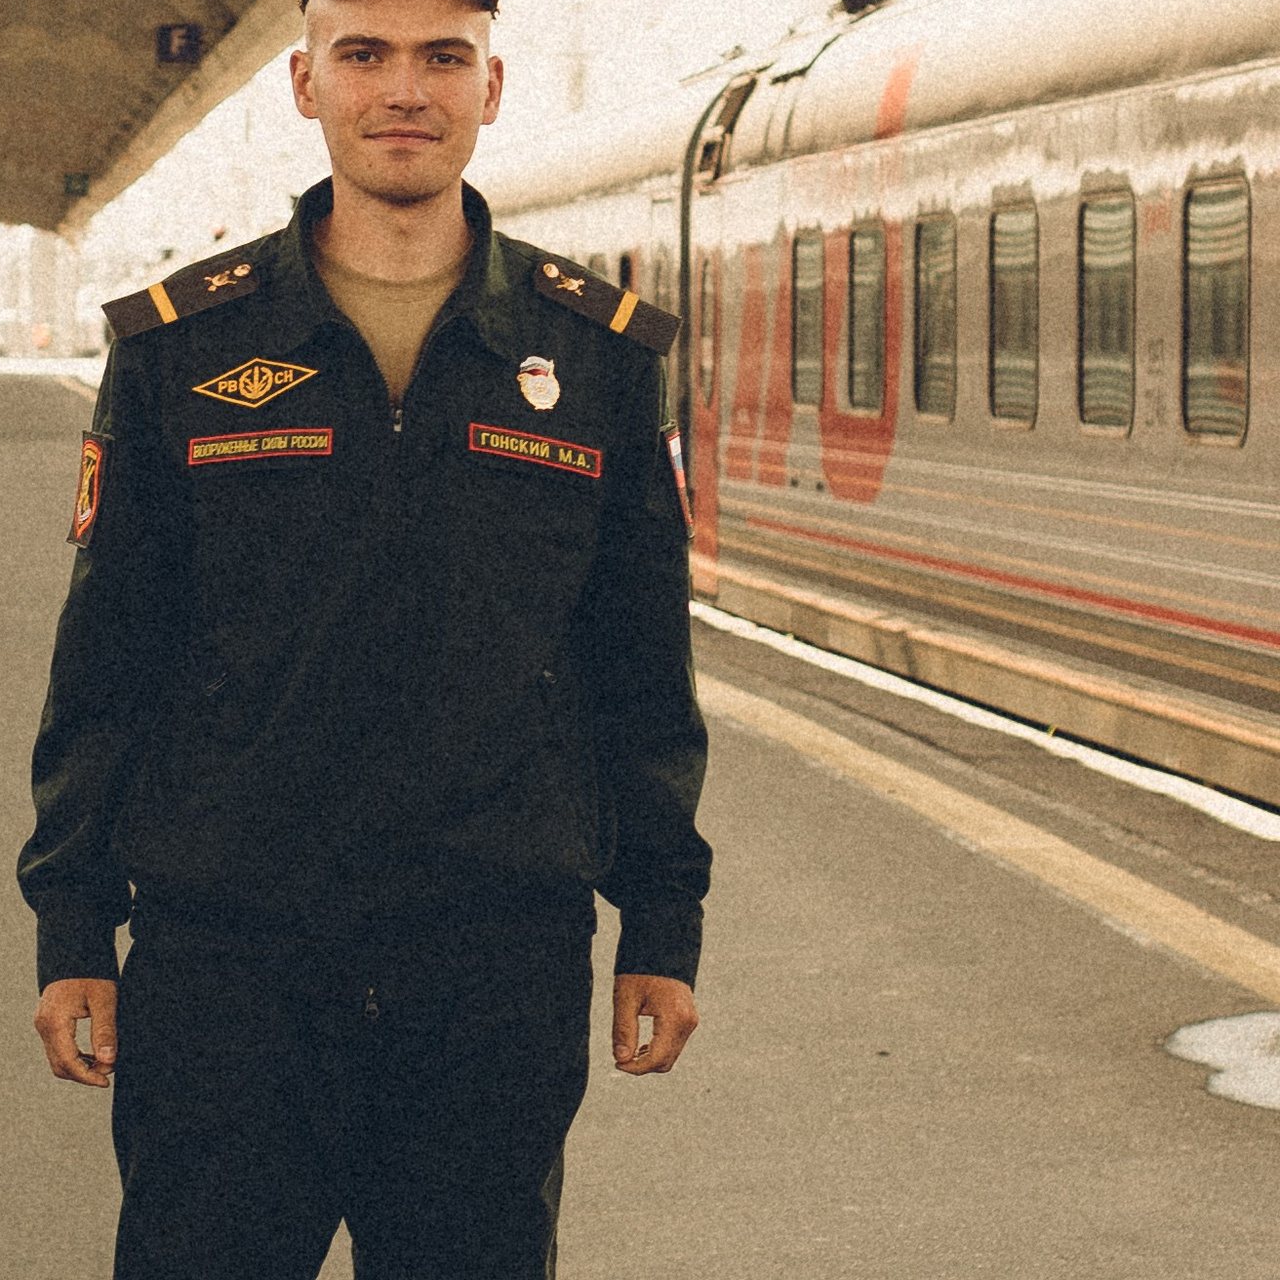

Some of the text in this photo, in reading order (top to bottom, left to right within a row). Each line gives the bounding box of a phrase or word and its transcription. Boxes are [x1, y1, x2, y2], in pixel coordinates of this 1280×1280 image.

[170, 29, 187, 55] F
[193, 435, 329, 459] ВООРУЖЕННЫЕ СИЛЫ РОССИИ
[480, 432, 591, 469] ГОНСКИЙ М.А.
